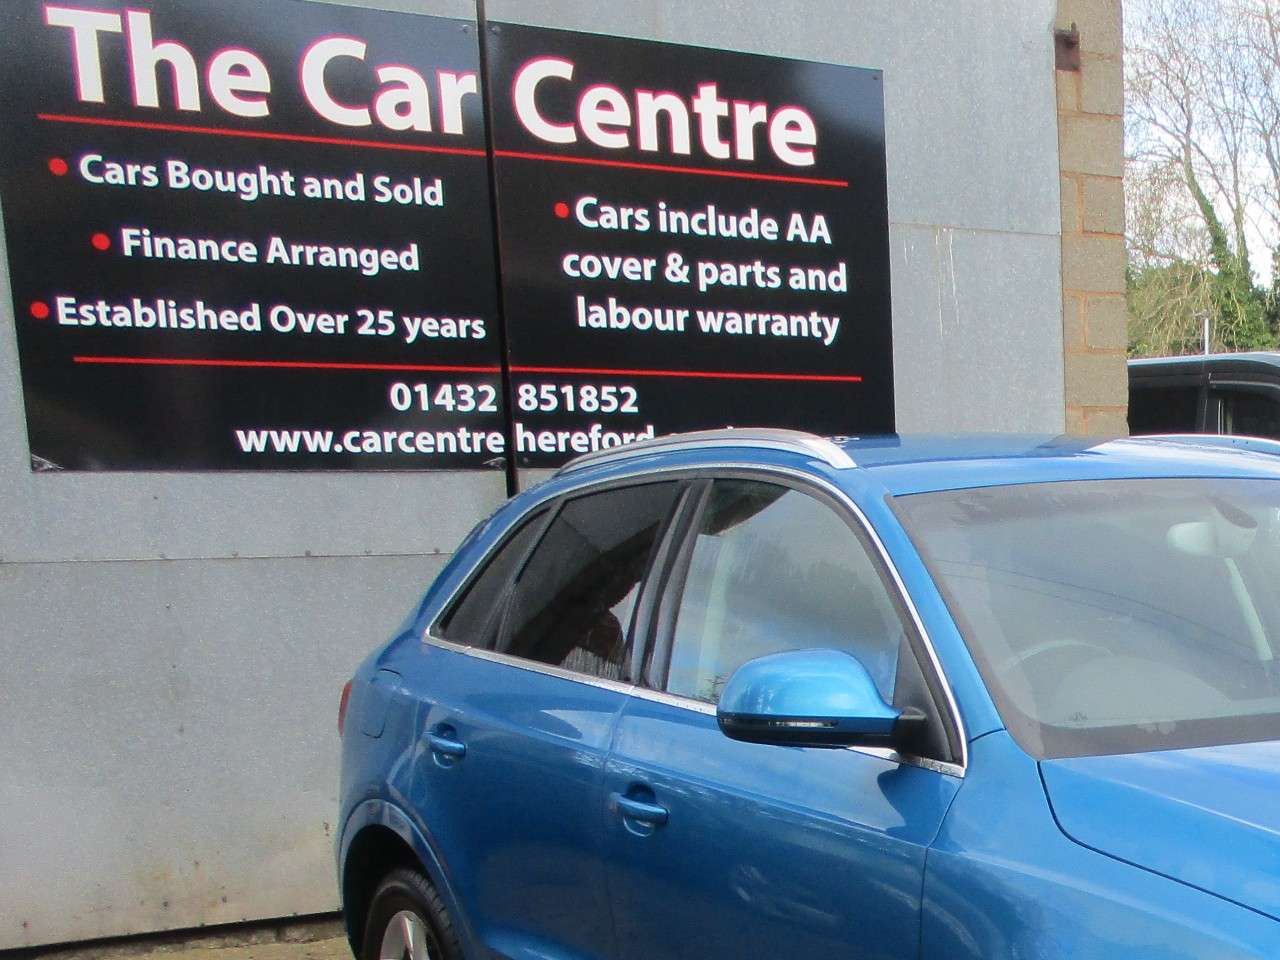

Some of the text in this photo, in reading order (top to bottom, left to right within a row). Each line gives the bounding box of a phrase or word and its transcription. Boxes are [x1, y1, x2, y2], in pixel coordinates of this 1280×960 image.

[44, 6, 817, 166] The Car Centre
[79, 155, 444, 206] Cars Bought and Sold
[575, 197, 832, 245] Cars include AA
[121, 228, 420, 276] Finance Arranged
[562, 252, 847, 293] cover & parts and
[56, 297, 486, 343] Established Over 25 years
[577, 297, 840, 346] labour warranty
[390, 382, 639, 414] 01432 851852
